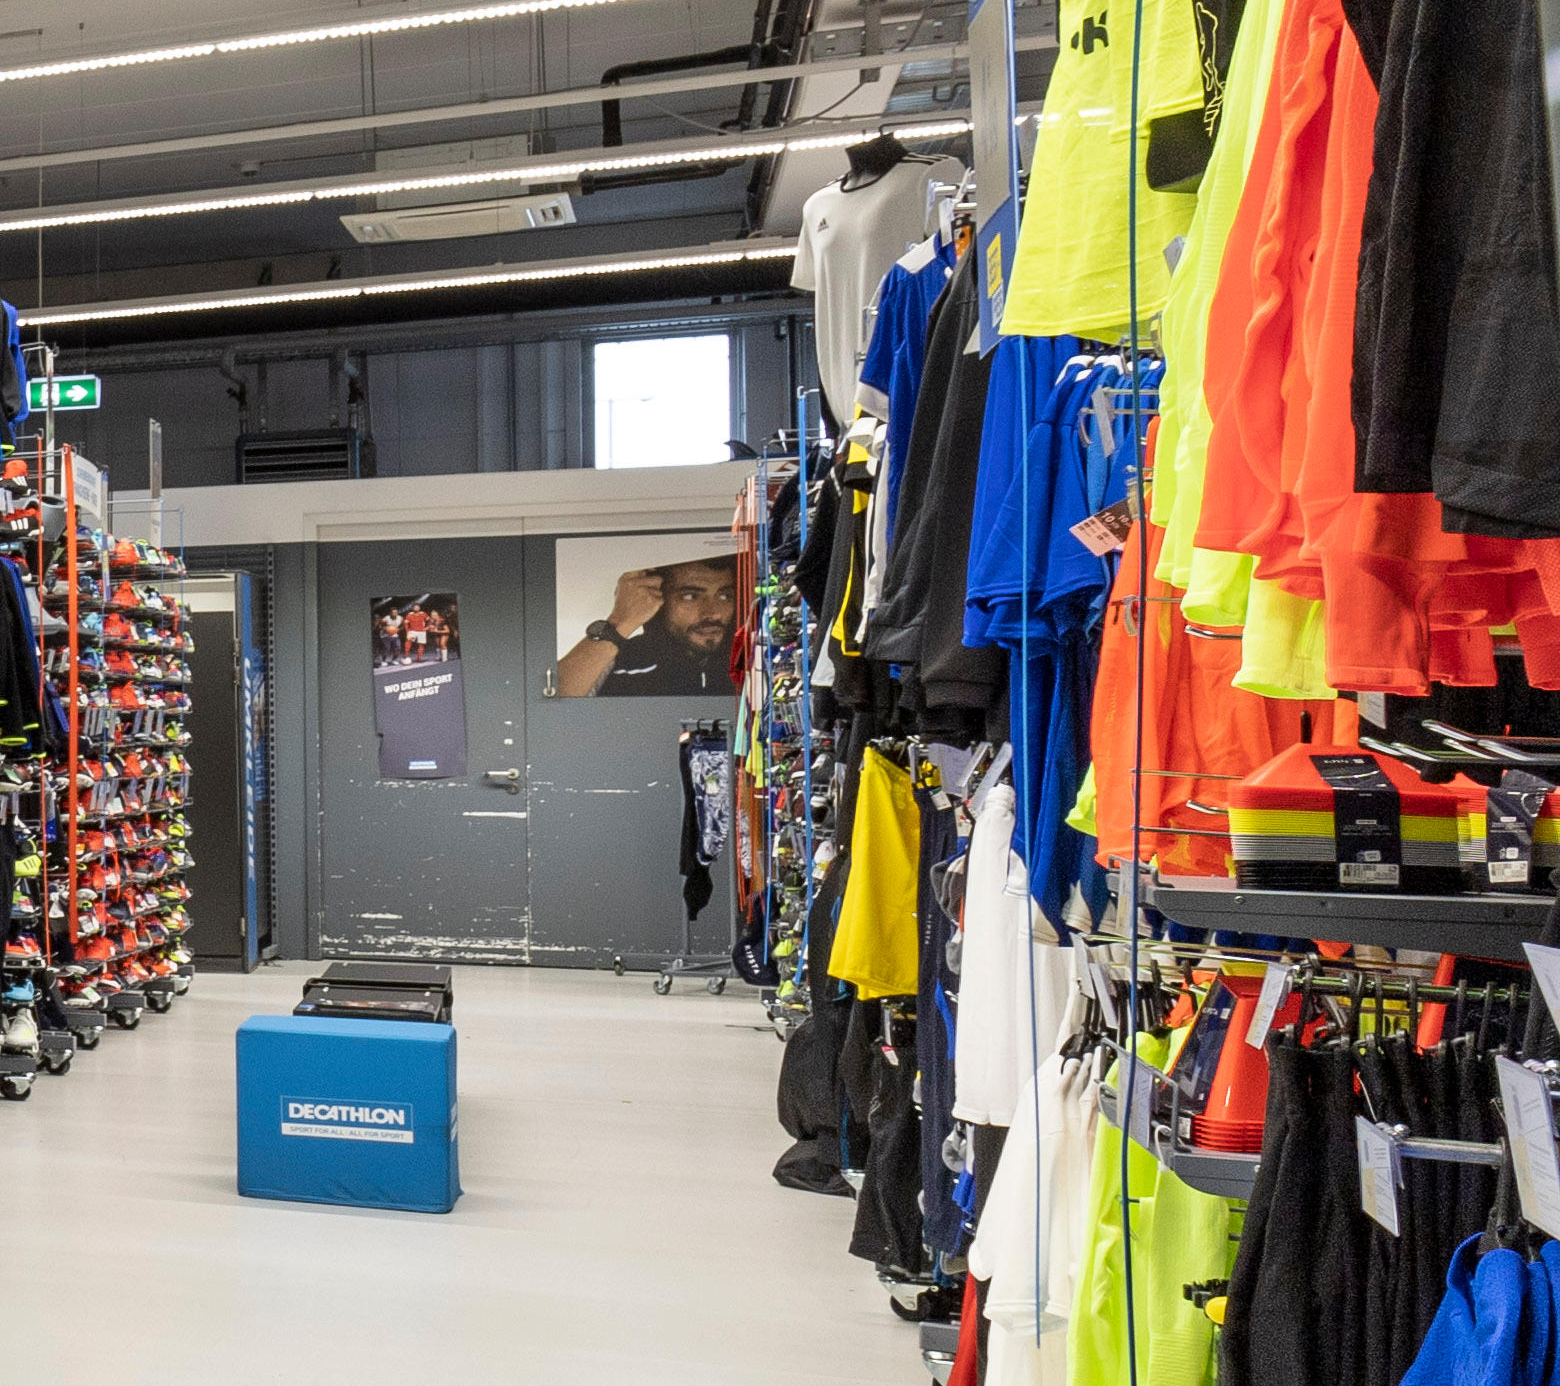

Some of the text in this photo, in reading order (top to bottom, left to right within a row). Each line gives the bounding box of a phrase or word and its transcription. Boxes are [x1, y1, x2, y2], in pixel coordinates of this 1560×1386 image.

[384, 673, 453, 694] WO DEIN SPORT
[288, 1102, 405, 1126] DECATHLON
[290, 1125, 314, 1134] SPORT
[315, 1126, 329, 1134] FOR
[380, 1131, 404, 1140] SPORT
